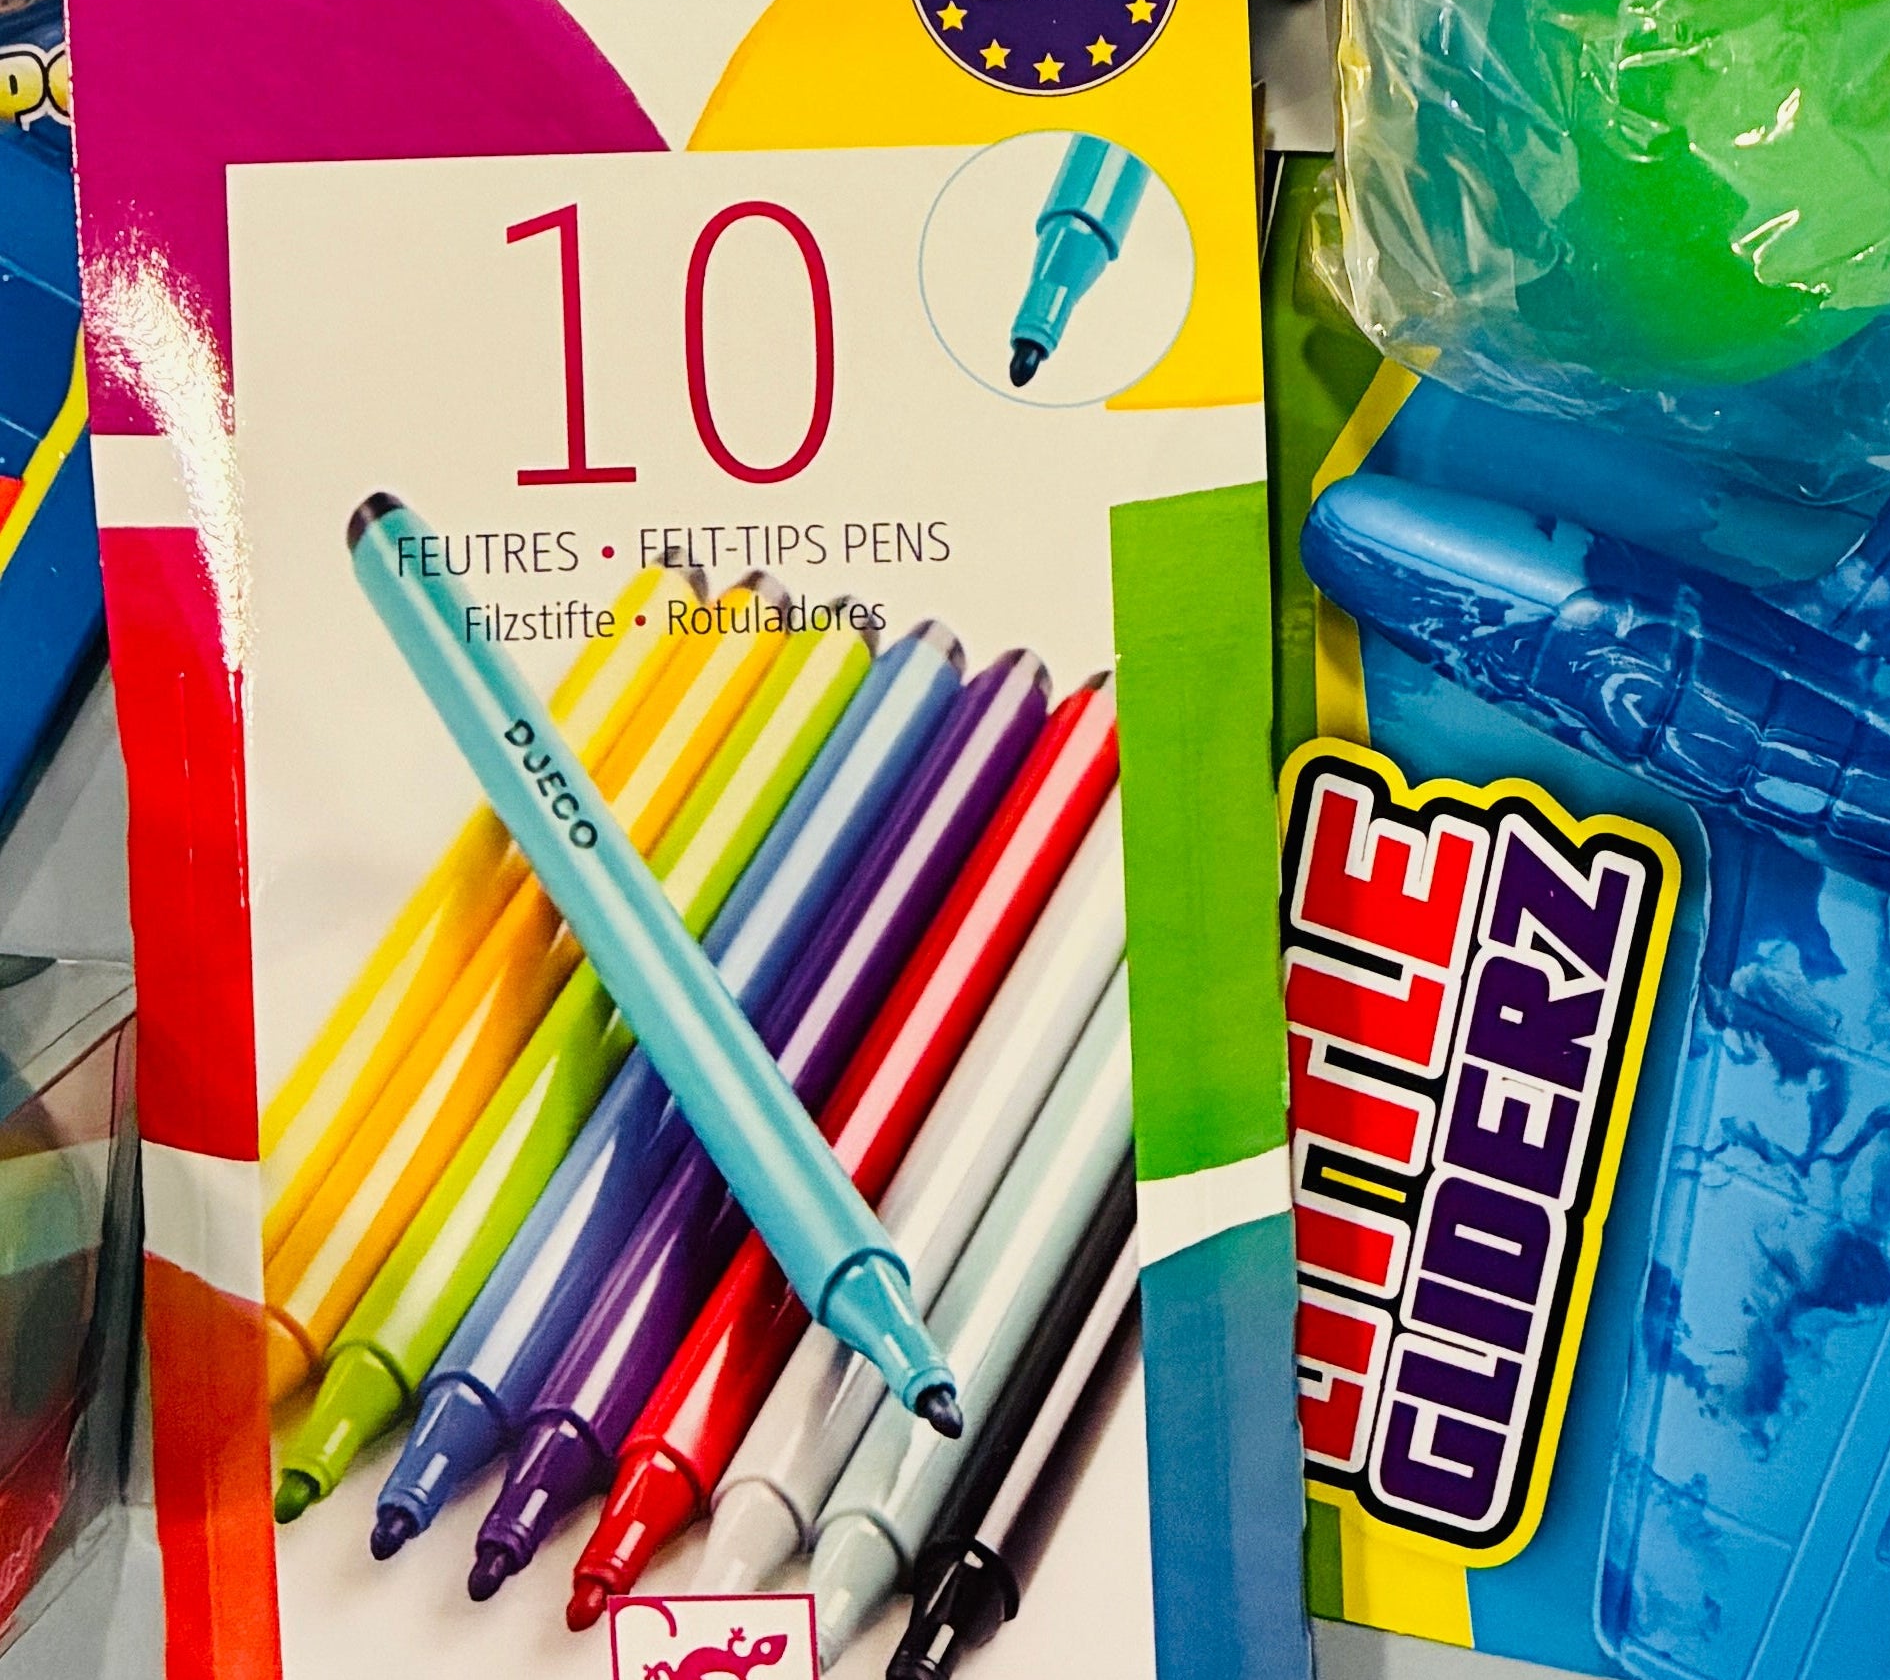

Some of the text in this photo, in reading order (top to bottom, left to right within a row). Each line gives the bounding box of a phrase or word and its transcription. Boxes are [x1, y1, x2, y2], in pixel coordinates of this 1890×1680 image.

[505, 200, 836, 487] 10
[397, 520, 951, 578] FEUTRES FELT-TIPS PENS
[464, 596, 888, 643] Filzstifte Rotuladores
[504, 718, 599, 853] DJECO
[1373, 826, 1637, 1526] GLIDERZ
